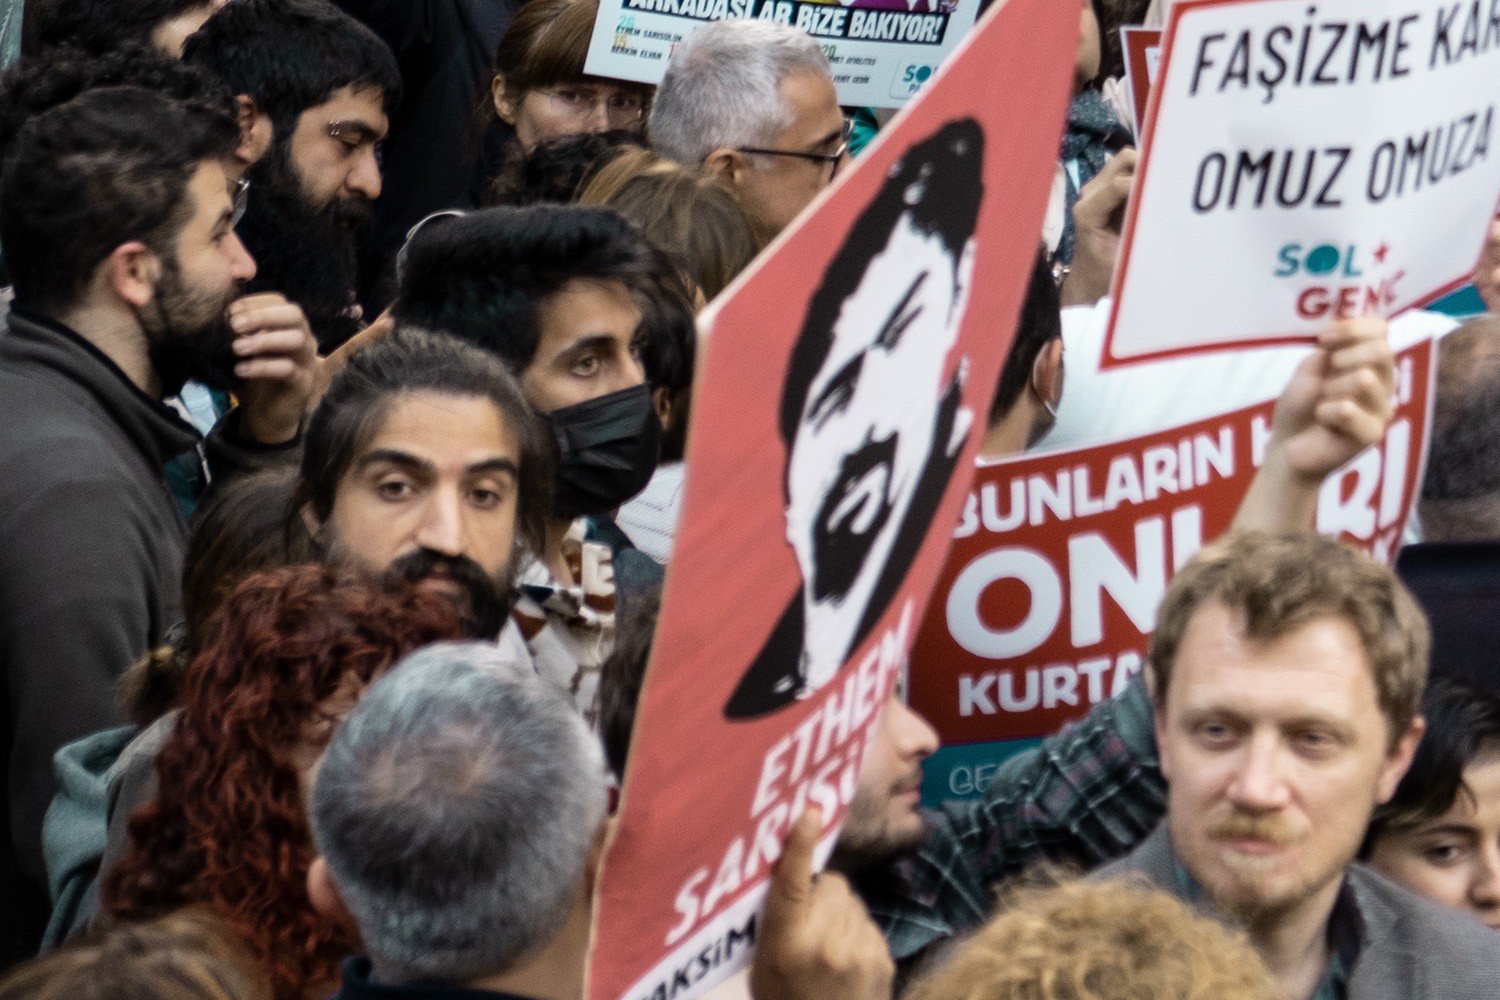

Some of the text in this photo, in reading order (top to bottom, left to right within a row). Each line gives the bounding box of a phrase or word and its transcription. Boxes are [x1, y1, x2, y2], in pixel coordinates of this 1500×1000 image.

[847, 10, 944, 42] BAKIYOR!
[1189, 4, 1420, 105] FAŞİZME
[1191, 147, 1352, 215] OMUZ
[1365, 105, 1495, 204] OMUZA
